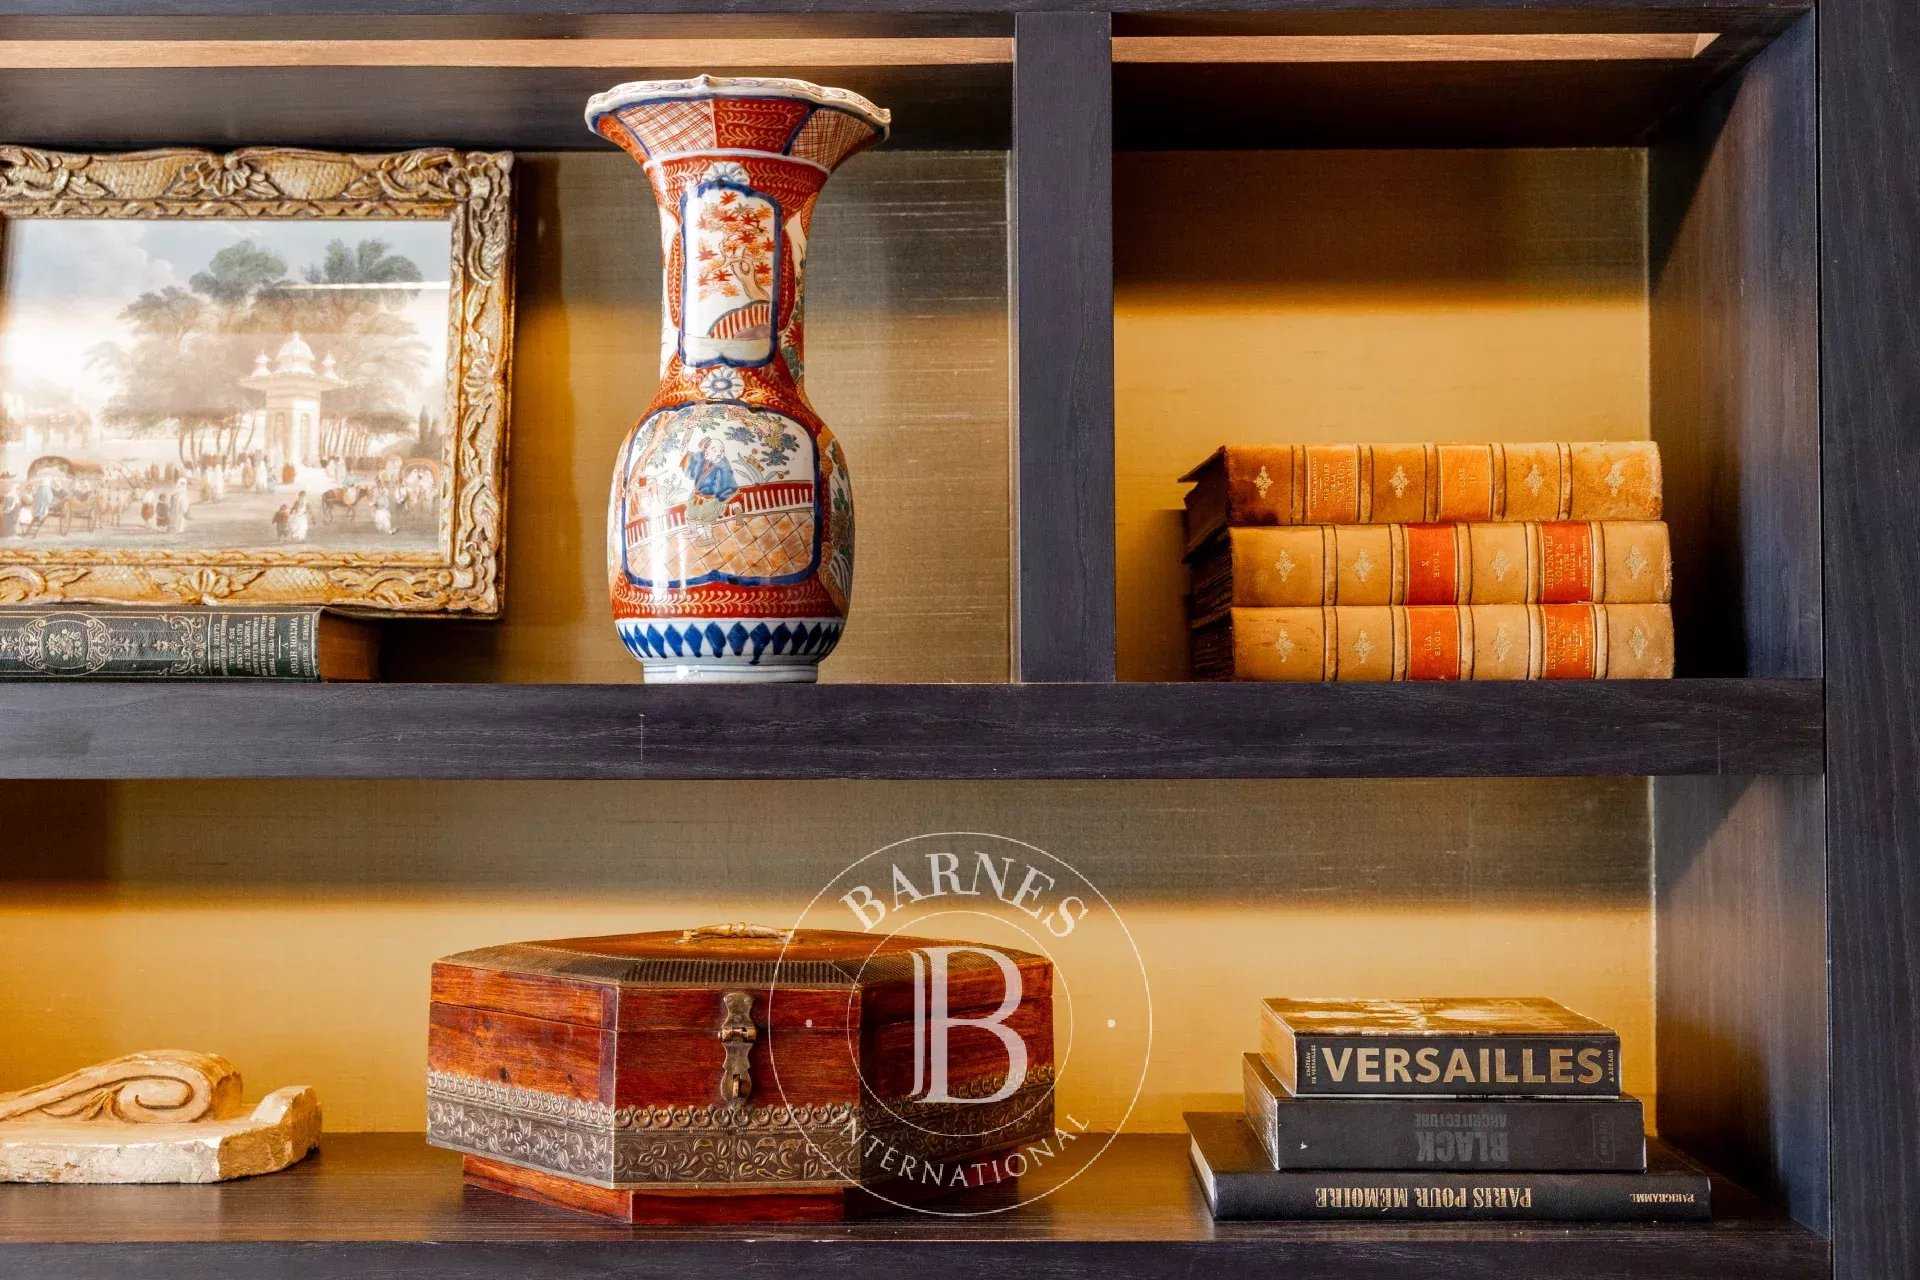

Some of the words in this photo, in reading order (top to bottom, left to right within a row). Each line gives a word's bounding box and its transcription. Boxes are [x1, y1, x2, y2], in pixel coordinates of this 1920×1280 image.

[289, 616, 299, 647] VICTOR
[289, 650, 299, 675] HUGO
[1321, 1047, 1604, 1085] VERSAILLES
[1415, 1112, 1508, 1129] ARCHITECTURE
[1415, 1131, 1510, 1163] BLACK
[1315, 1187, 1409, 1212] MÉMOIRE
[1414, 1187, 1467, 1208] POUR
[1473, 1187, 1532, 1208] PARIS
